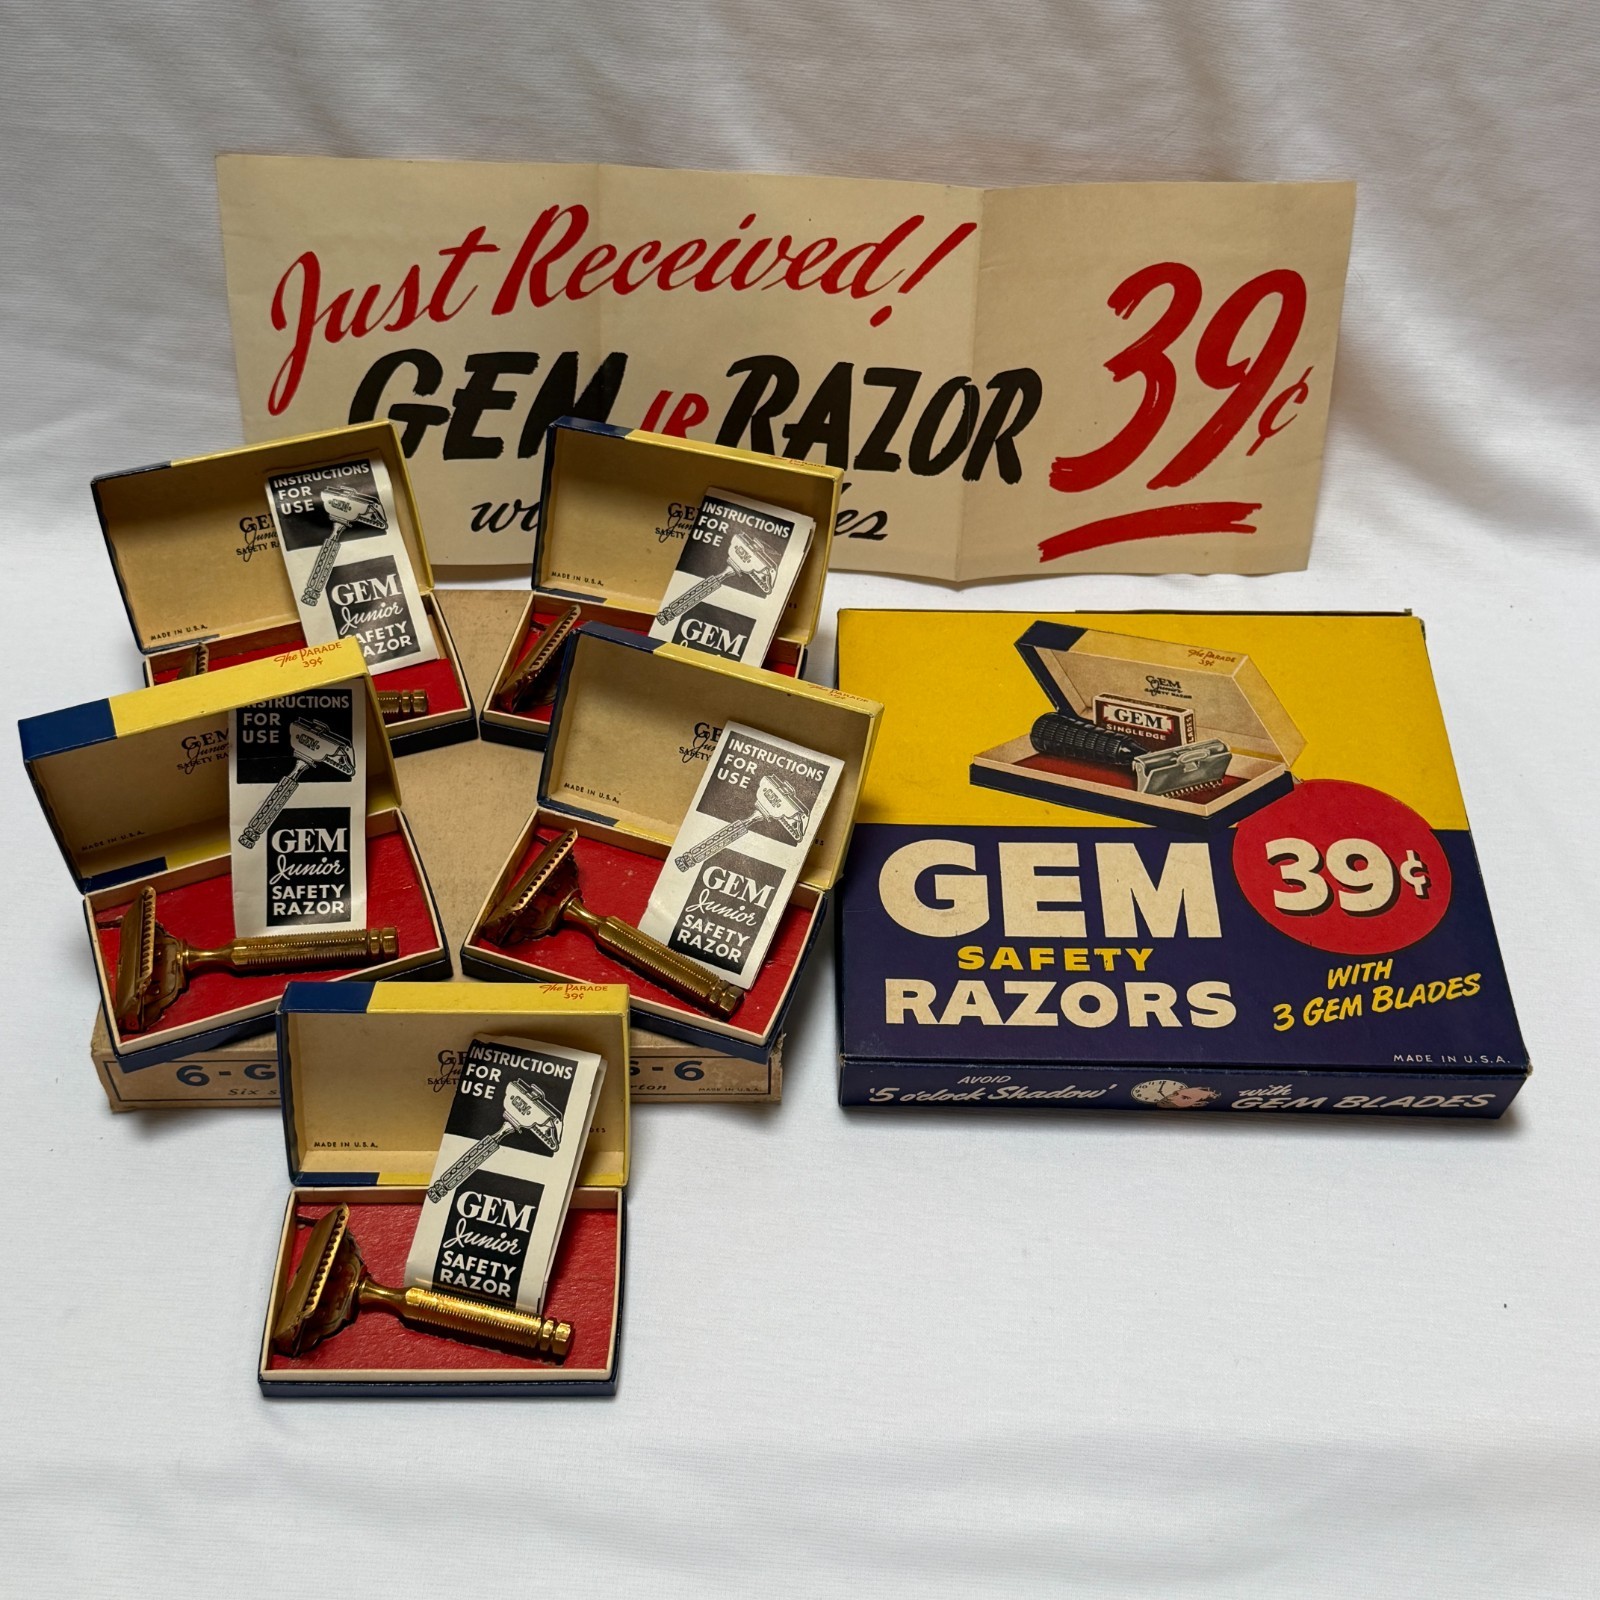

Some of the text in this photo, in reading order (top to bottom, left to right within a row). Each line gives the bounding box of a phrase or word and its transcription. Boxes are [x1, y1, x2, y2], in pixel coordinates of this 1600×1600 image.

[267, 204, 977, 416] Just Received!
[347, 348, 628, 461] GEM
[714, 354, 1043, 485] RAZOR
[273, 463, 370, 488] INSTRUCTIONS
[278, 486, 313, 500] FOR
[281, 499, 315, 515] USE
[668, 502, 700, 521] GE
[698, 515, 729, 534] FOR
[702, 501, 790, 539] INSTRUCTIONS
[692, 529, 723, 547] USE
[551, 571, 570, 580] MADE
[331, 573, 402, 606] GEM
[339, 601, 404, 636] Junior
[150, 631, 171, 641] MADE
[344, 620, 407, 645] AFETY
[681, 618, 747, 657] GEM
[273, 641, 342, 668] The PARADE
[363, 635, 412, 658] AZOR
[1145, 675, 1181, 689] GEM
[243, 695, 350, 709] STRUCTIONS
[243, 713, 281, 726] FOR
[1113, 708, 1163, 730] GEM
[1184, 715, 1195, 745] LADES
[242, 730, 280, 744] USE
[694, 722, 724, 743] GE
[1106, 723, 1167, 741] SINGLEDGE
[723, 753, 758, 775] FOR
[728, 739, 824, 782] INSTRUCTIONS
[564, 782, 584, 793] MADE
[717, 768, 751, 789] USE
[271, 828, 348, 854] GEM
[269, 854, 345, 885] Junior
[1265, 837, 1430, 912] 39¢
[272, 884, 345, 900] SAFETY
[702, 866, 775, 909] GEM
[878, 839, 1223, 939] GEM
[273, 901, 345, 916] RAZOR
[685, 888, 757, 926] Junior
[682, 914, 750, 947] SAFETY
[676, 929, 742, 963] RAZOR
[957, 945, 1154, 971] SAFETY
[1327, 958, 1394, 990] WITH
[539, 983, 609, 994] The PARADE
[884, 978, 1237, 1029] RAZORS
[1272, 972, 1483, 1032] 3 GEM BLADES
[469, 1046, 573, 1080] INSTRUCTIONS
[1393, 1054, 1511, 1064] MADE IN U.S.A.
[427, 1077, 459, 1086] SAFET
[465, 1063, 502, 1083] FOR
[957, 1075, 1012, 1084] AVOID
[460, 1080, 496, 1100] USE
[1231, 1093, 1497, 1109] GEM BLADES
[1238, 1084, 1293, 1097] with
[456, 1191, 536, 1233] GEM
[443, 1217, 521, 1256] Junior
[441, 1250, 517, 1281] SAFETY
[440, 1268, 511, 1298] RAZOR
